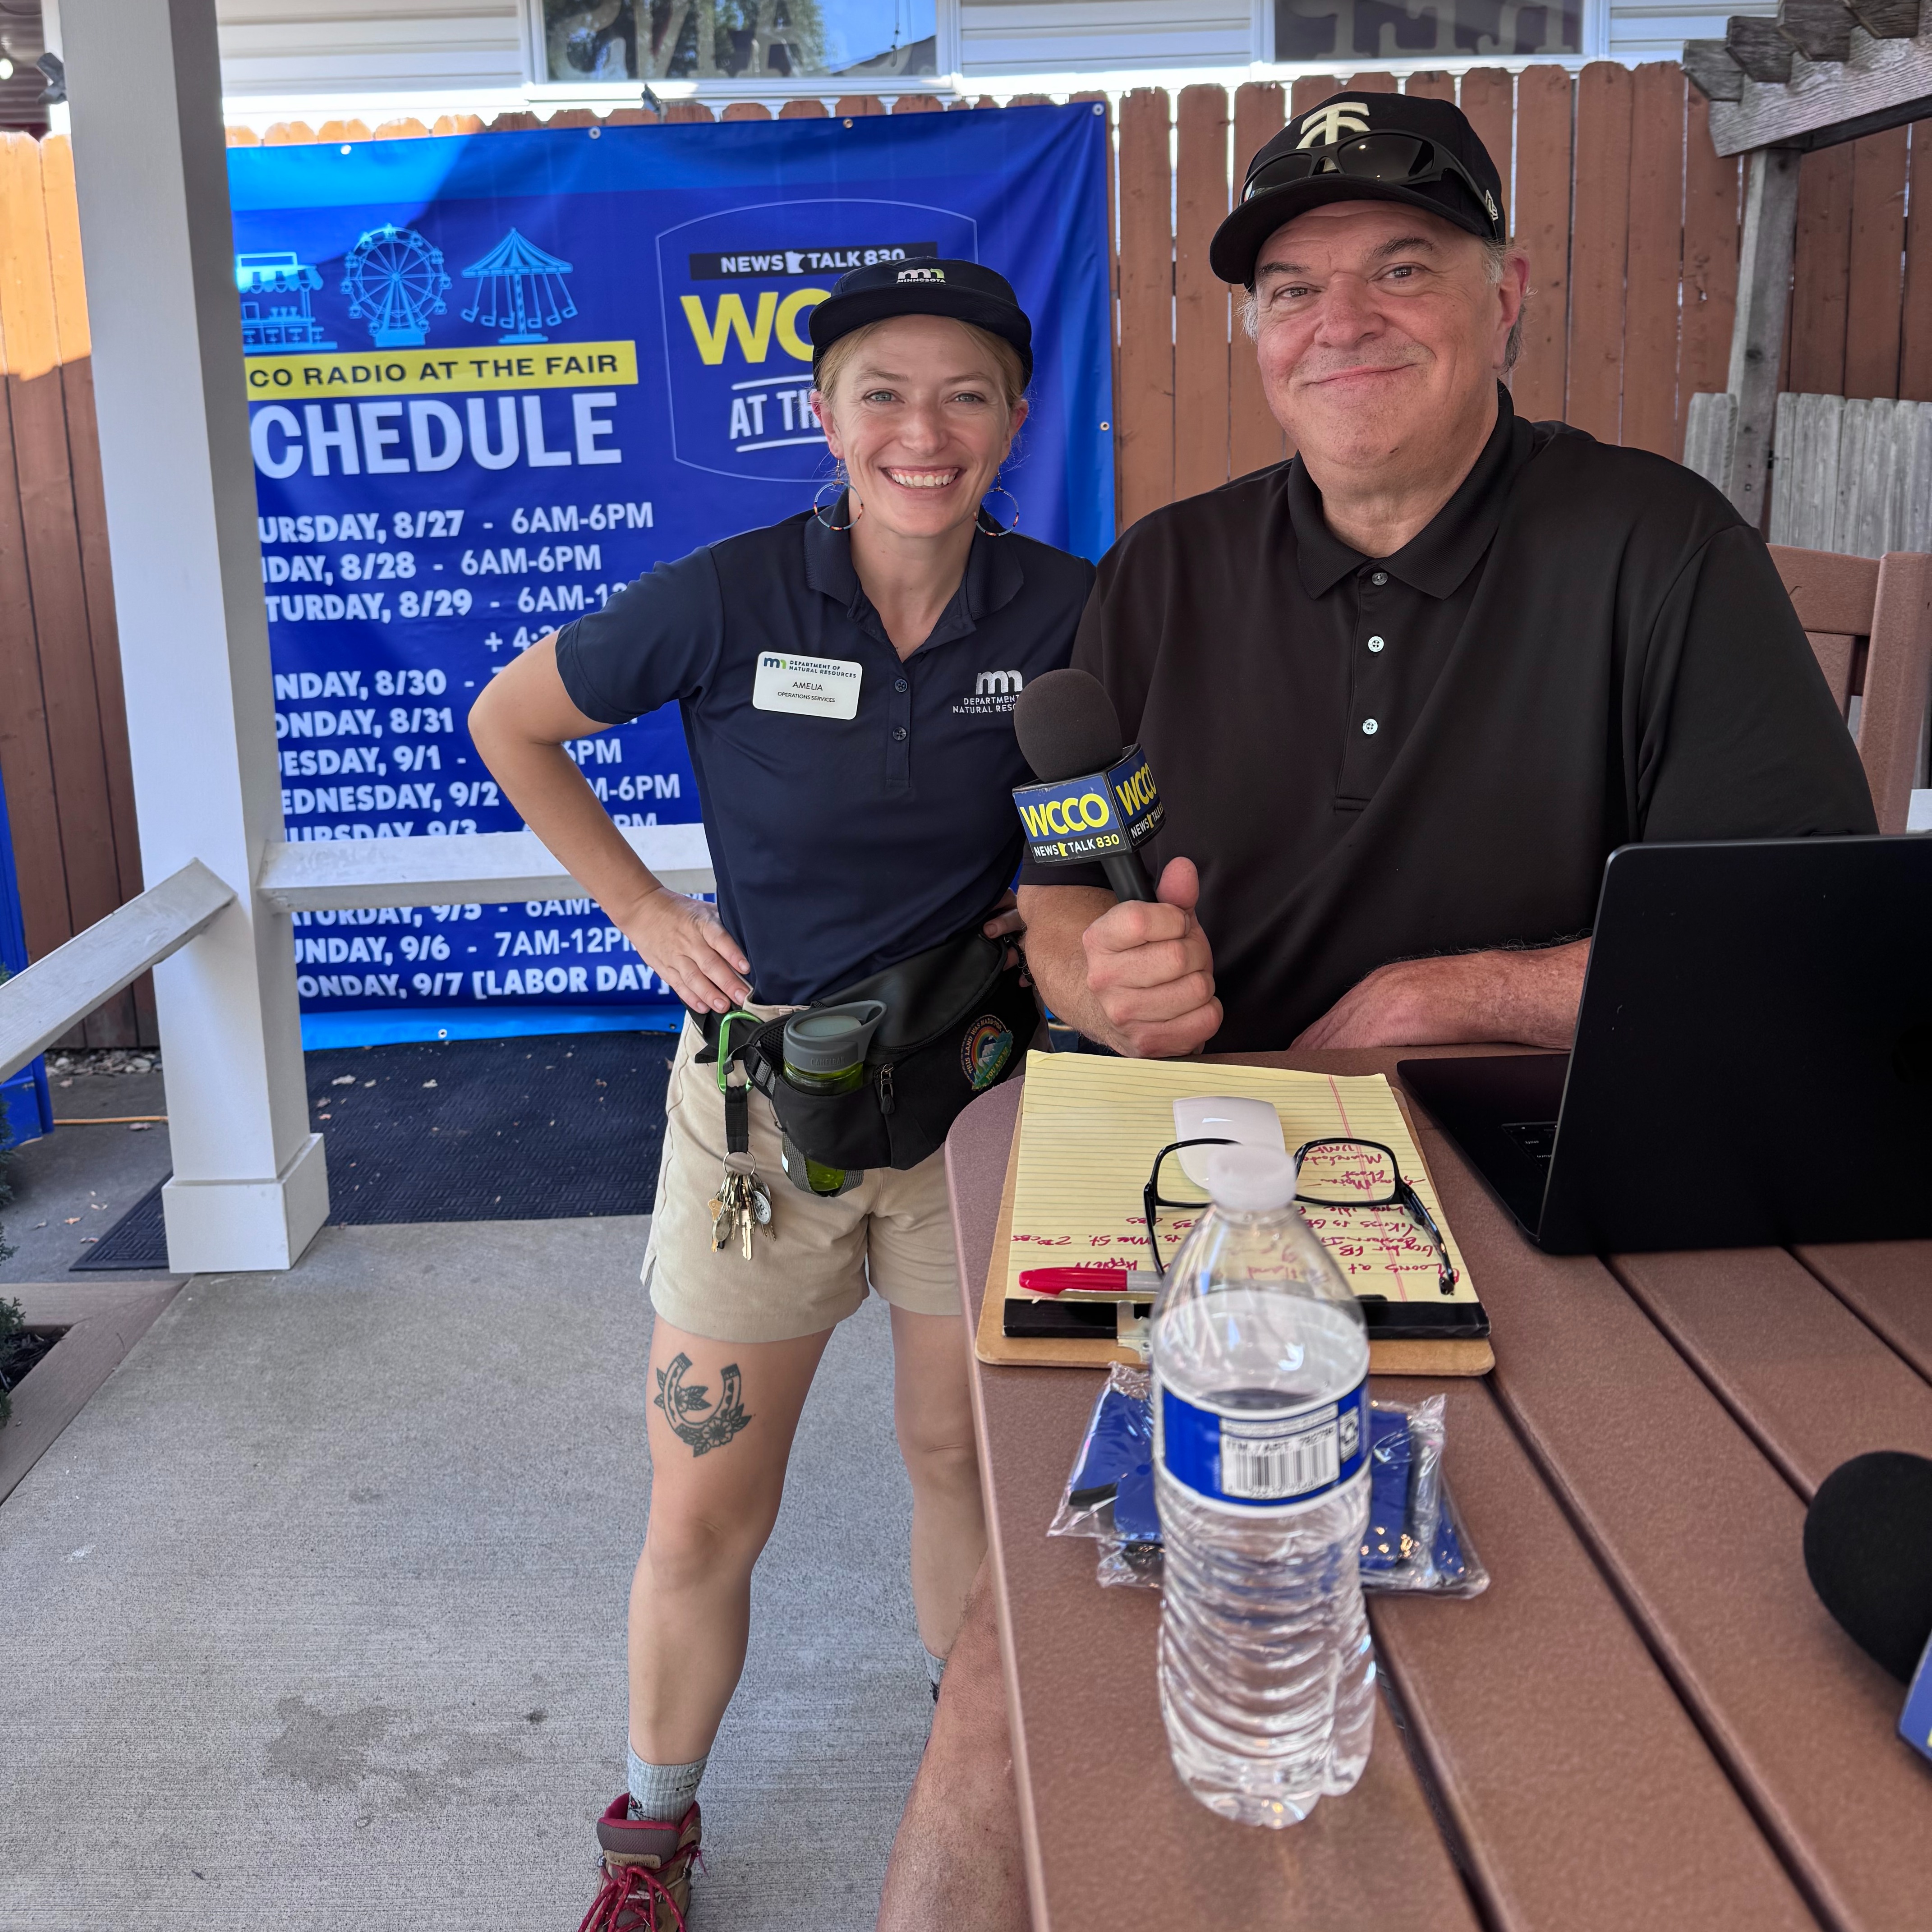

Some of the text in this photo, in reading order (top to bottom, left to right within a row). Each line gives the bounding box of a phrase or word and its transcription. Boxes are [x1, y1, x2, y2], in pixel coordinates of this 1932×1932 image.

[721, 248, 906, 273] NEWS TALK 830
[680, 287, 831, 365] WC
[249, 354, 618, 388] CO RADIO AT THE FAIR
[729, 389, 822, 440] AT TH
[250, 391, 623, 480] CHEDULE
[258, 513, 386, 544] URSDAY,
[393, 510, 465, 539] 8/27
[511, 502, 654, 534] 6AM-6PM
[261, 555, 333, 586] IDAY,
[340, 551, 417, 581] 8/28
[461, 544, 602, 576] 6AM-6PM
[264, 592, 391, 624] TURDAY,
[399, 589, 473, 618] 8/29
[790, 660, 830, 670] DEPARTMENT
[820, 669, 856, 678] RESOURCES
[275, 670, 368, 701] NDAY,
[374, 669, 447, 696] 8/30
[777, 691, 810, 699] OPERATIONS
[792, 681, 823, 691] AMELIA
[275, 707, 454, 739] ONDAY, 8/31
[952, 705, 993, 714] NATURAL
[277, 747, 386, 777] ESDAY,
[393, 745, 441, 772] 9/1
[281, 782, 442, 815] EDNESDAY,
[448, 781, 500, 808] 9/2
[1116, 762, 1157, 816] WCCO
[1020, 793, 1109, 837] WCCO
[1131, 818, 1149, 838] NEWS
[1034, 834, 1120, 857] NEWS TALK 830
[295, 936, 393, 966] UNDAY,
[400, 935, 451, 961] 9/6
[297, 973, 407, 999] ONDAY,
[412, 972, 463, 996] 9/7
[473, 966, 591, 1000] [LABOR
[965, 1036, 974, 1055] LAND
[971, 1022, 981, 1035] WAS
[986, 1067, 996, 1080] YOU
